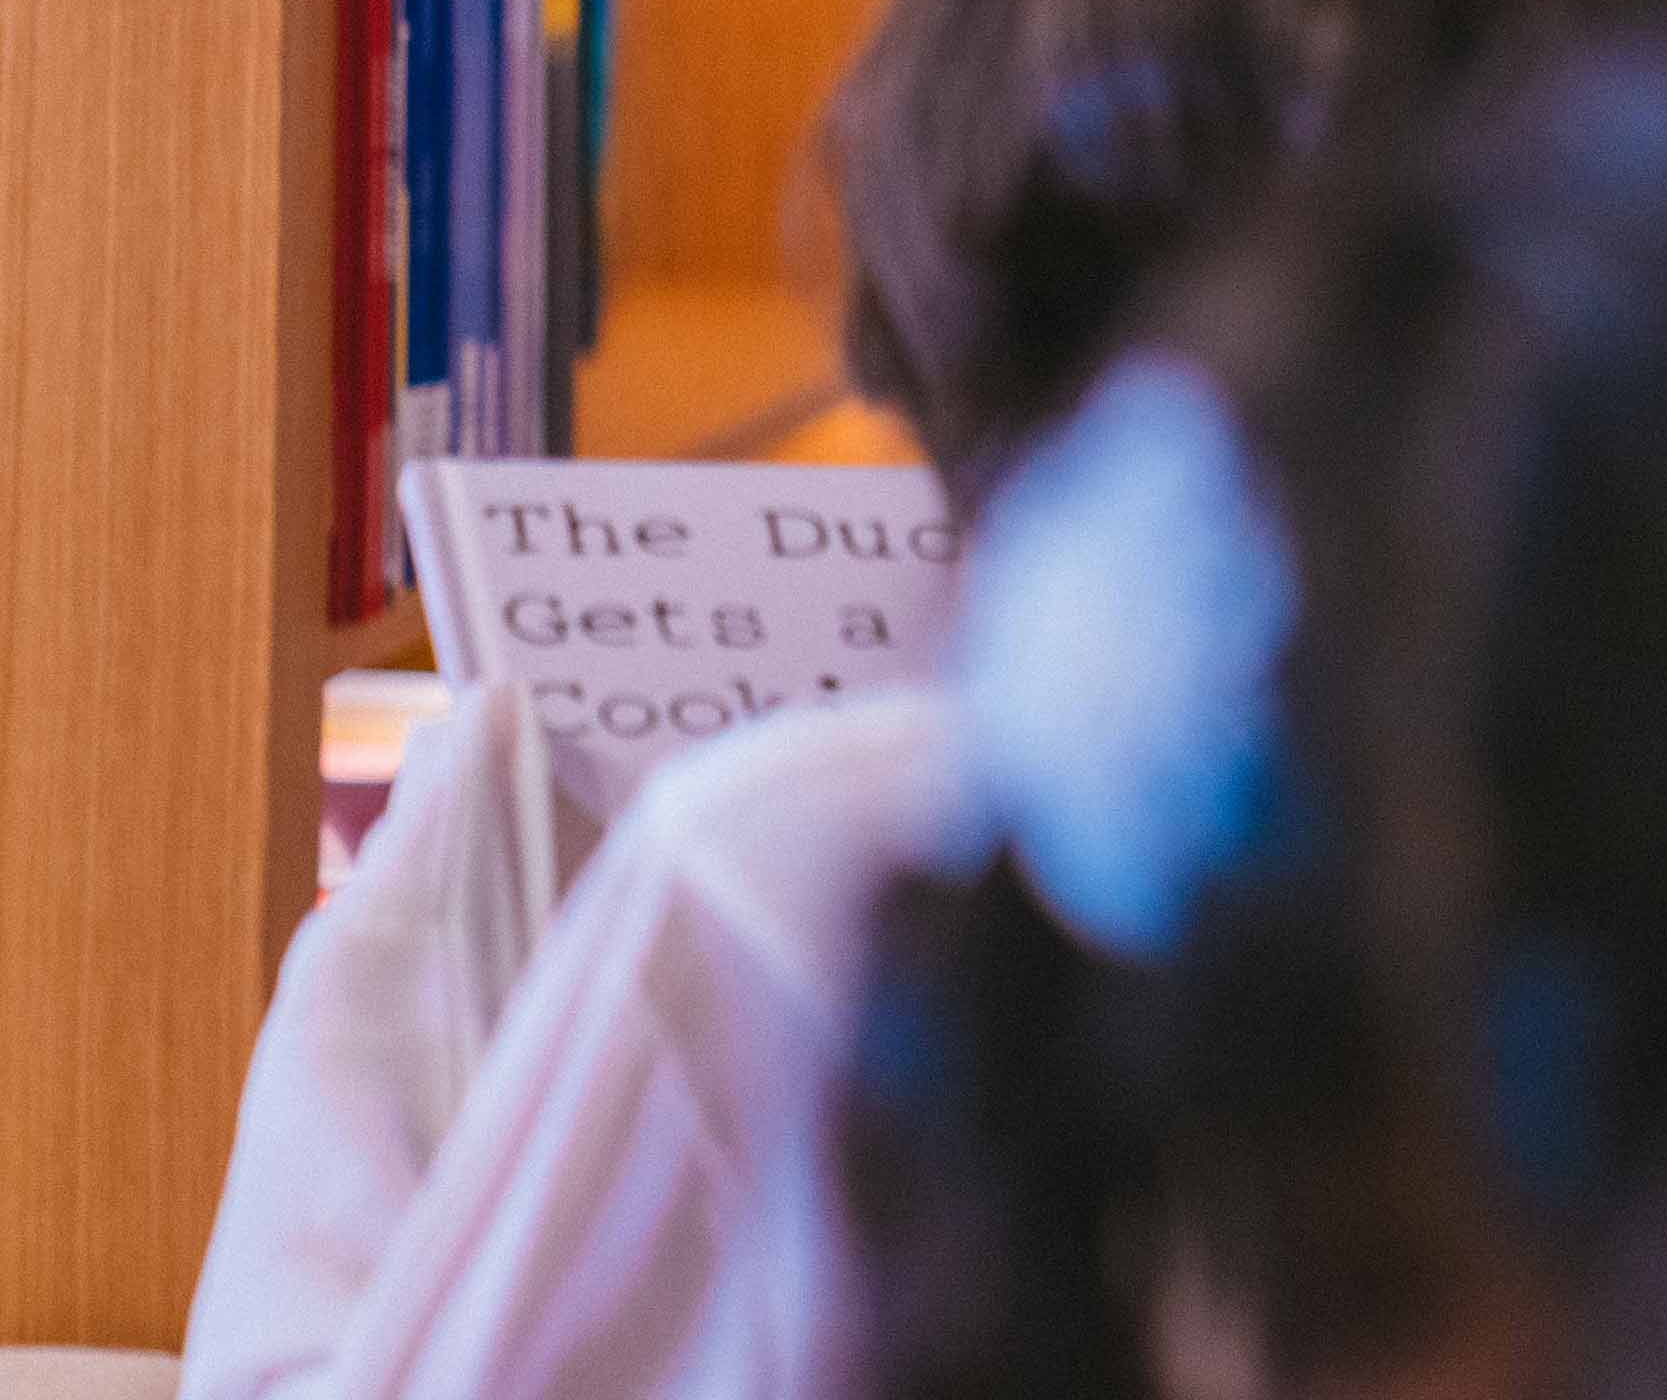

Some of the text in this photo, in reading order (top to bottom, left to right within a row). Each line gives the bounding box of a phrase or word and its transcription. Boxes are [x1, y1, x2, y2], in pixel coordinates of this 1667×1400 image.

[481, 502, 692, 559] The
[505, 594, 893, 650] Gets a
